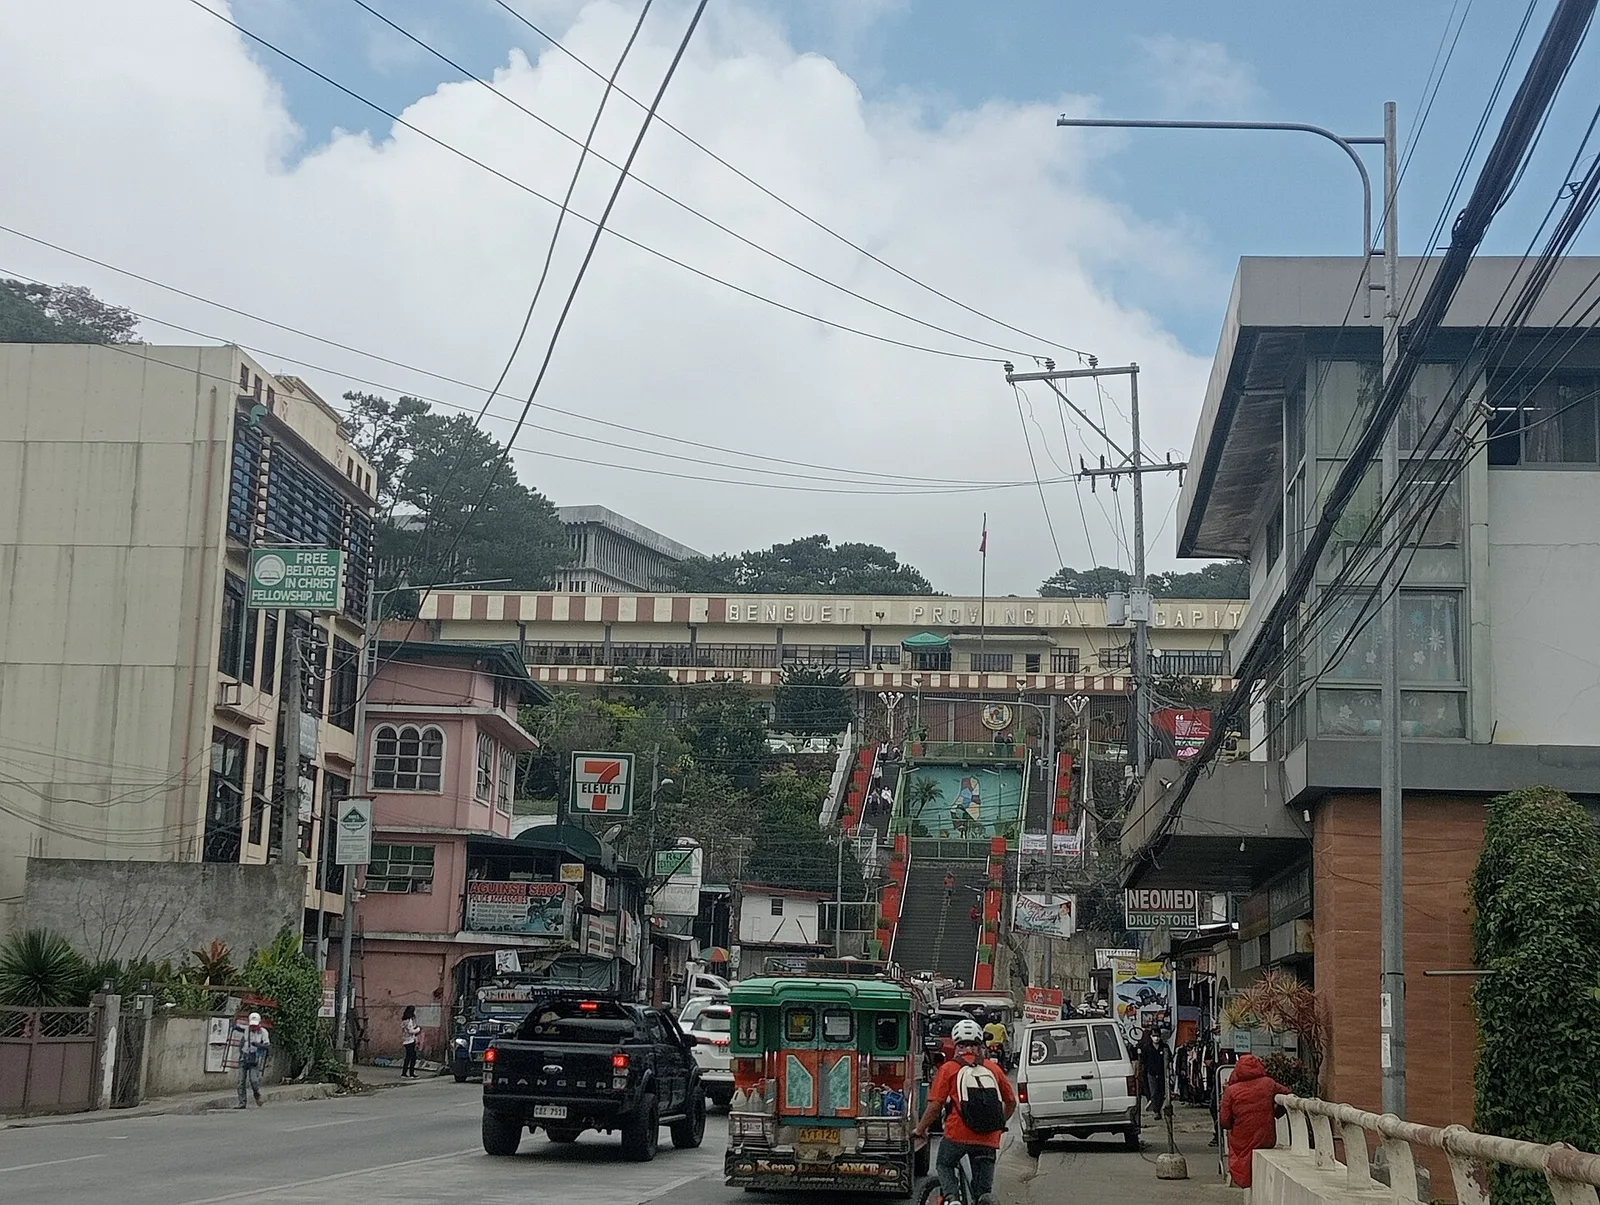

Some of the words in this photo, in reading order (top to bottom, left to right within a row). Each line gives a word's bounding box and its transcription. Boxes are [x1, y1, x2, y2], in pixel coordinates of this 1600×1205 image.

[296, 552, 328, 564] FREE
[286, 565, 336, 577] BELIEVERS
[285, 578, 296, 588] IN
[298, 578, 336, 589] CHRIST
[252, 590, 314, 602] FELLOWSHIP,
[729, 604, 851, 622] BENGUET
[912, 605, 1090, 626] PROVINCIAL
[529, 885, 565, 897] SHOP
[1128, 889, 1195, 909] NEOMED
[1128, 914, 1195, 926] DRUGSTORE
[498, 1077, 607, 1089] RANGER
